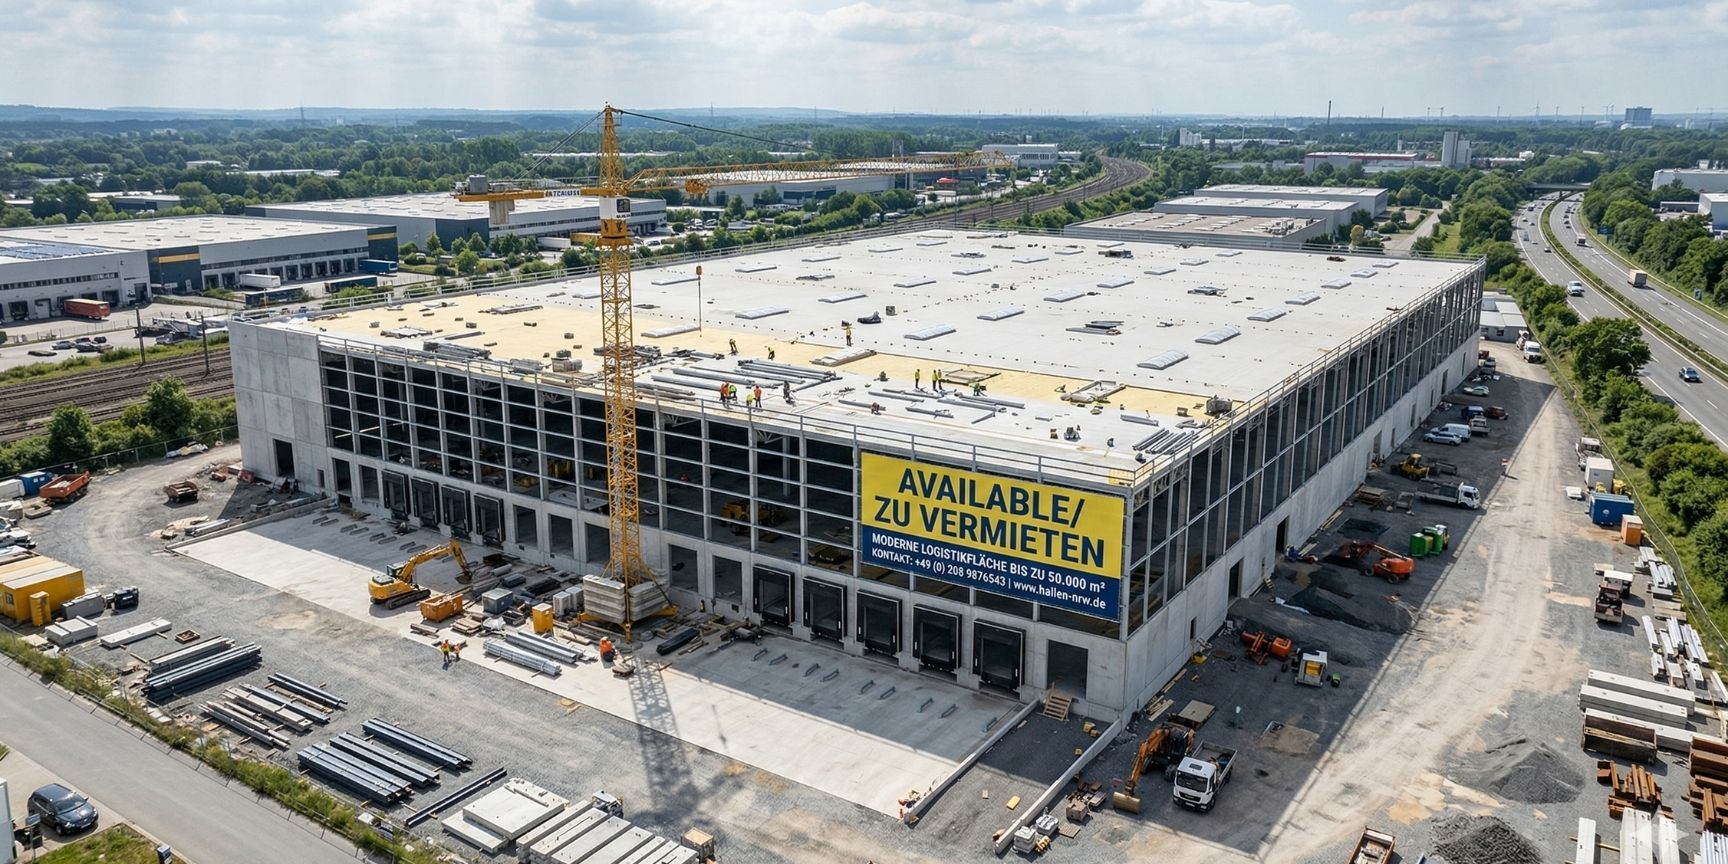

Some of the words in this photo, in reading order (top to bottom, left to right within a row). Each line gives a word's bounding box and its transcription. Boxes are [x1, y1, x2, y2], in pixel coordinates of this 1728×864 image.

[898, 467, 1085, 528] AVAILABLE/
[874, 495, 911, 527] ZU
[919, 504, 1104, 568] VERMIETEN
[872, 533, 919, 553] MODERNE
[921, 543, 1008, 573] LOGISTIKFLÄCHE
[1010, 562, 1028, 577] BIS
[1030, 567, 1045, 581] ZU
[1048, 571, 1087, 590] 50.000
[1089, 582, 1106, 593] m²
[872, 548, 913, 565] KONTAKT:
[915, 558, 931, 570] +49
[933, 560, 946, 575] (0)
[947, 564, 964, 577] 208
[966, 568, 1006, 587] 9876543
[1013, 581, 1107, 609] www.hallen-nrw.de
